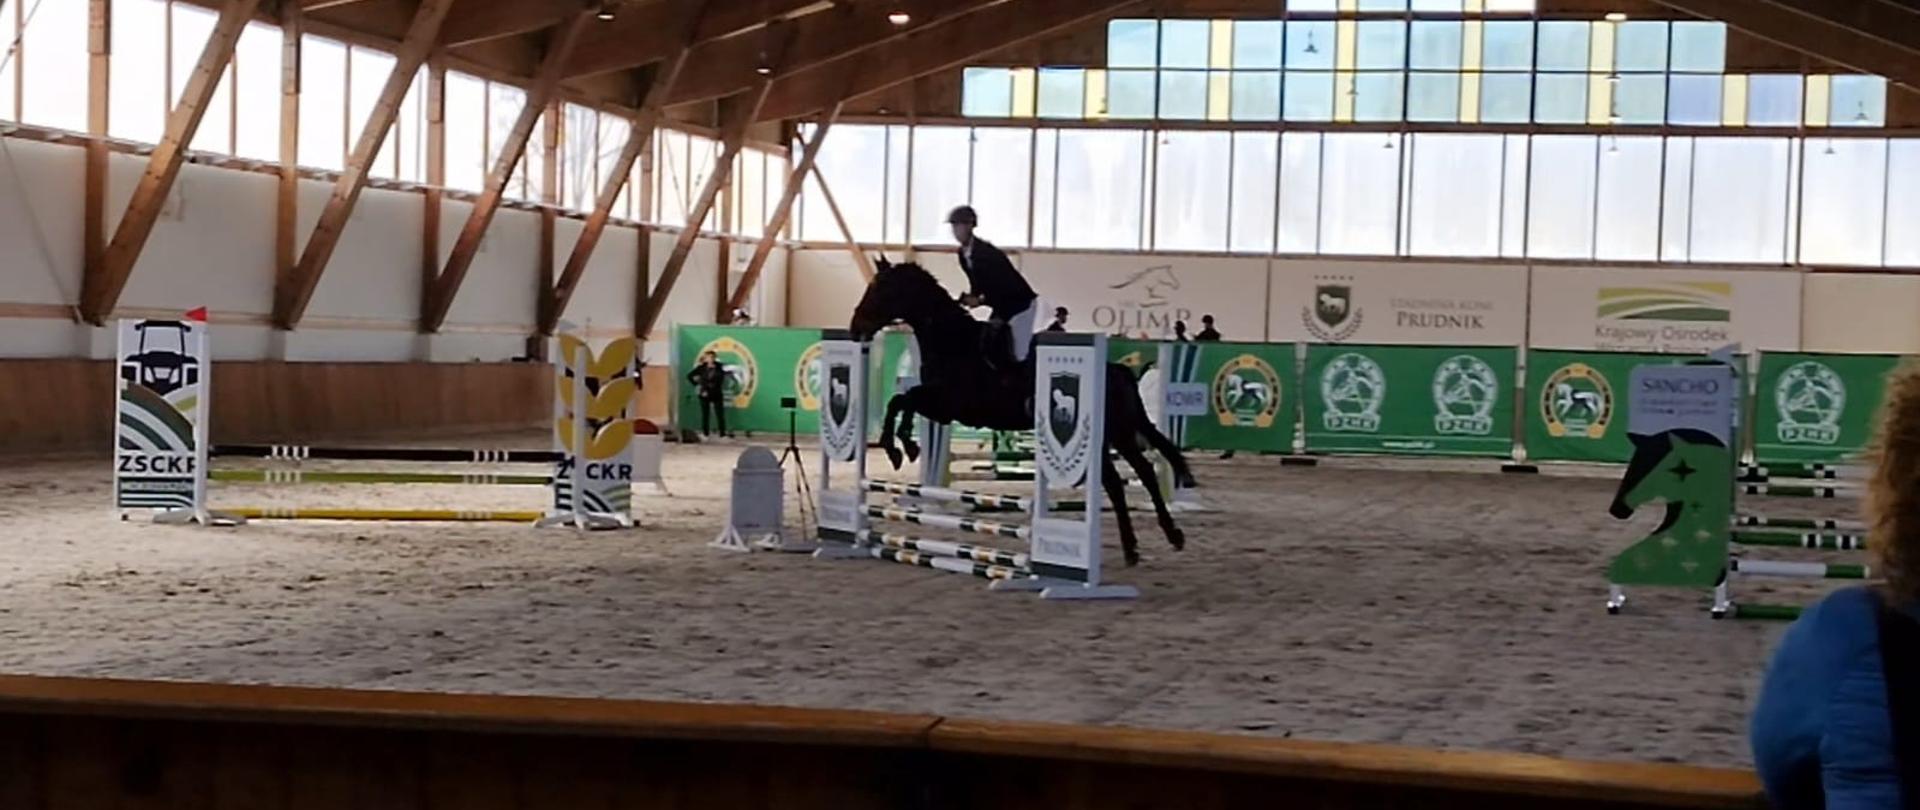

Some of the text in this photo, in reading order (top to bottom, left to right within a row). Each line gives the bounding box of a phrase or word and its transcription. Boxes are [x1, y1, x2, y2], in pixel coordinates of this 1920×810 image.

[1092, 305, 1191, 330] OLIMP
[1397, 310, 1484, 328] PRUDNIK
[1595, 325, 1656, 341] Krajowy
[1641, 377, 1719, 394] SANCHO
[557, 459, 632, 480] ZCKR
